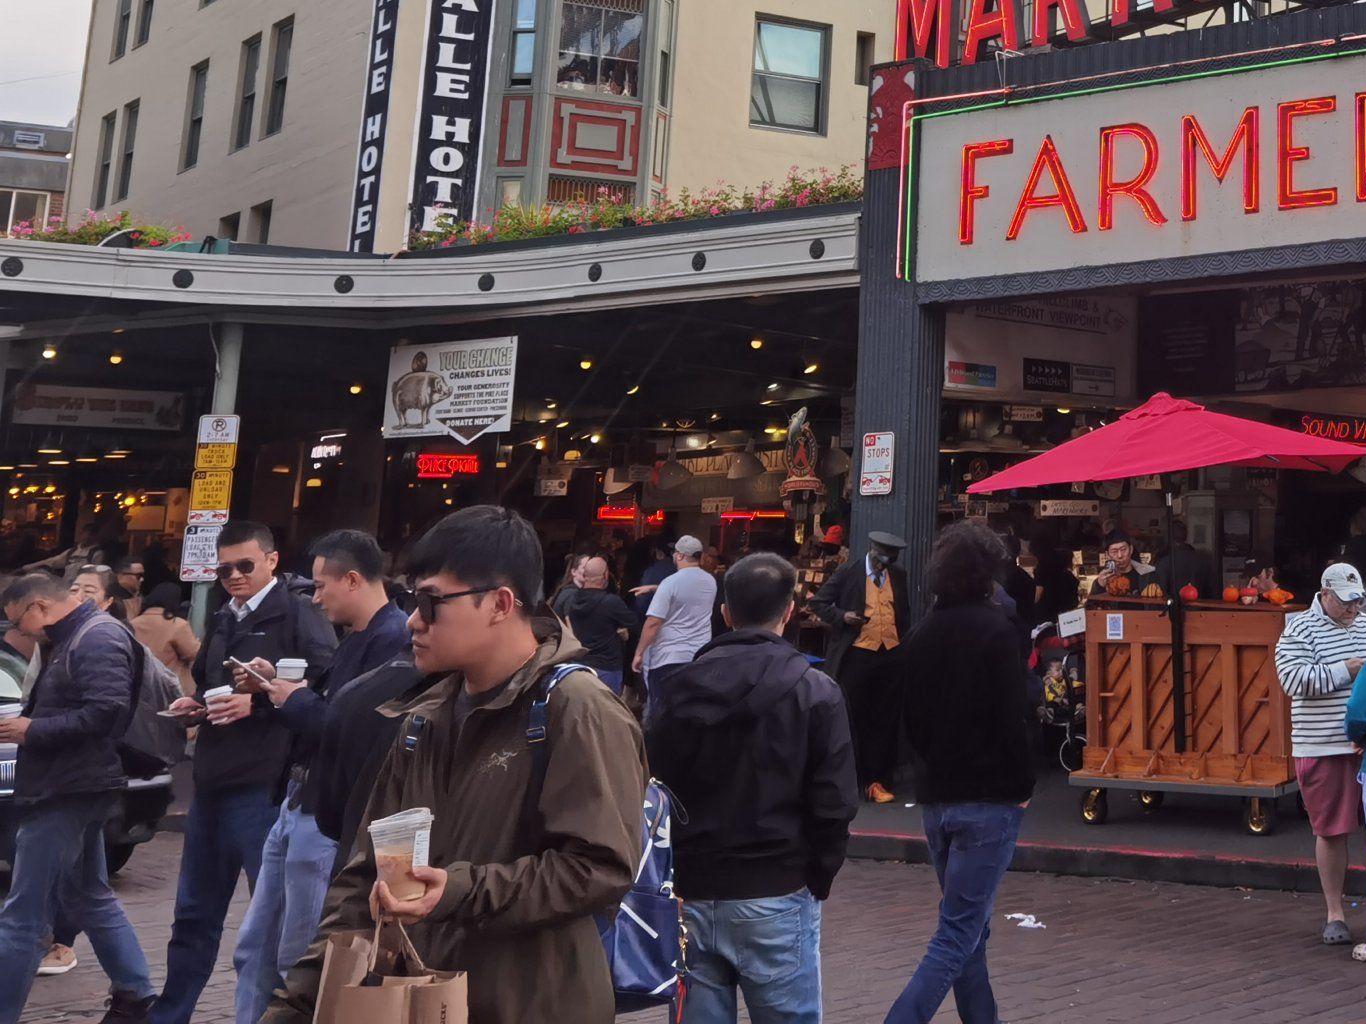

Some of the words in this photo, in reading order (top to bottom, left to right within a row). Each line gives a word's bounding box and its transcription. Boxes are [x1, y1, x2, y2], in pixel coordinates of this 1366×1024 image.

[420, 114, 471, 233] HOTE
[975, 302, 1045, 322] WATERFRONT
[1050, 310, 1102, 328] VIEWPOINT
[439, 351, 468, 371] YOUR
[468, 346, 513, 369] CHANGE
[449, 370, 485, 380] CHANGES
[486, 367, 512, 377] LIVES!
[446, 418, 473, 427] DONATE
[1301, 415, 1350, 438] SOUND
[867, 448, 890, 458] STOPS
